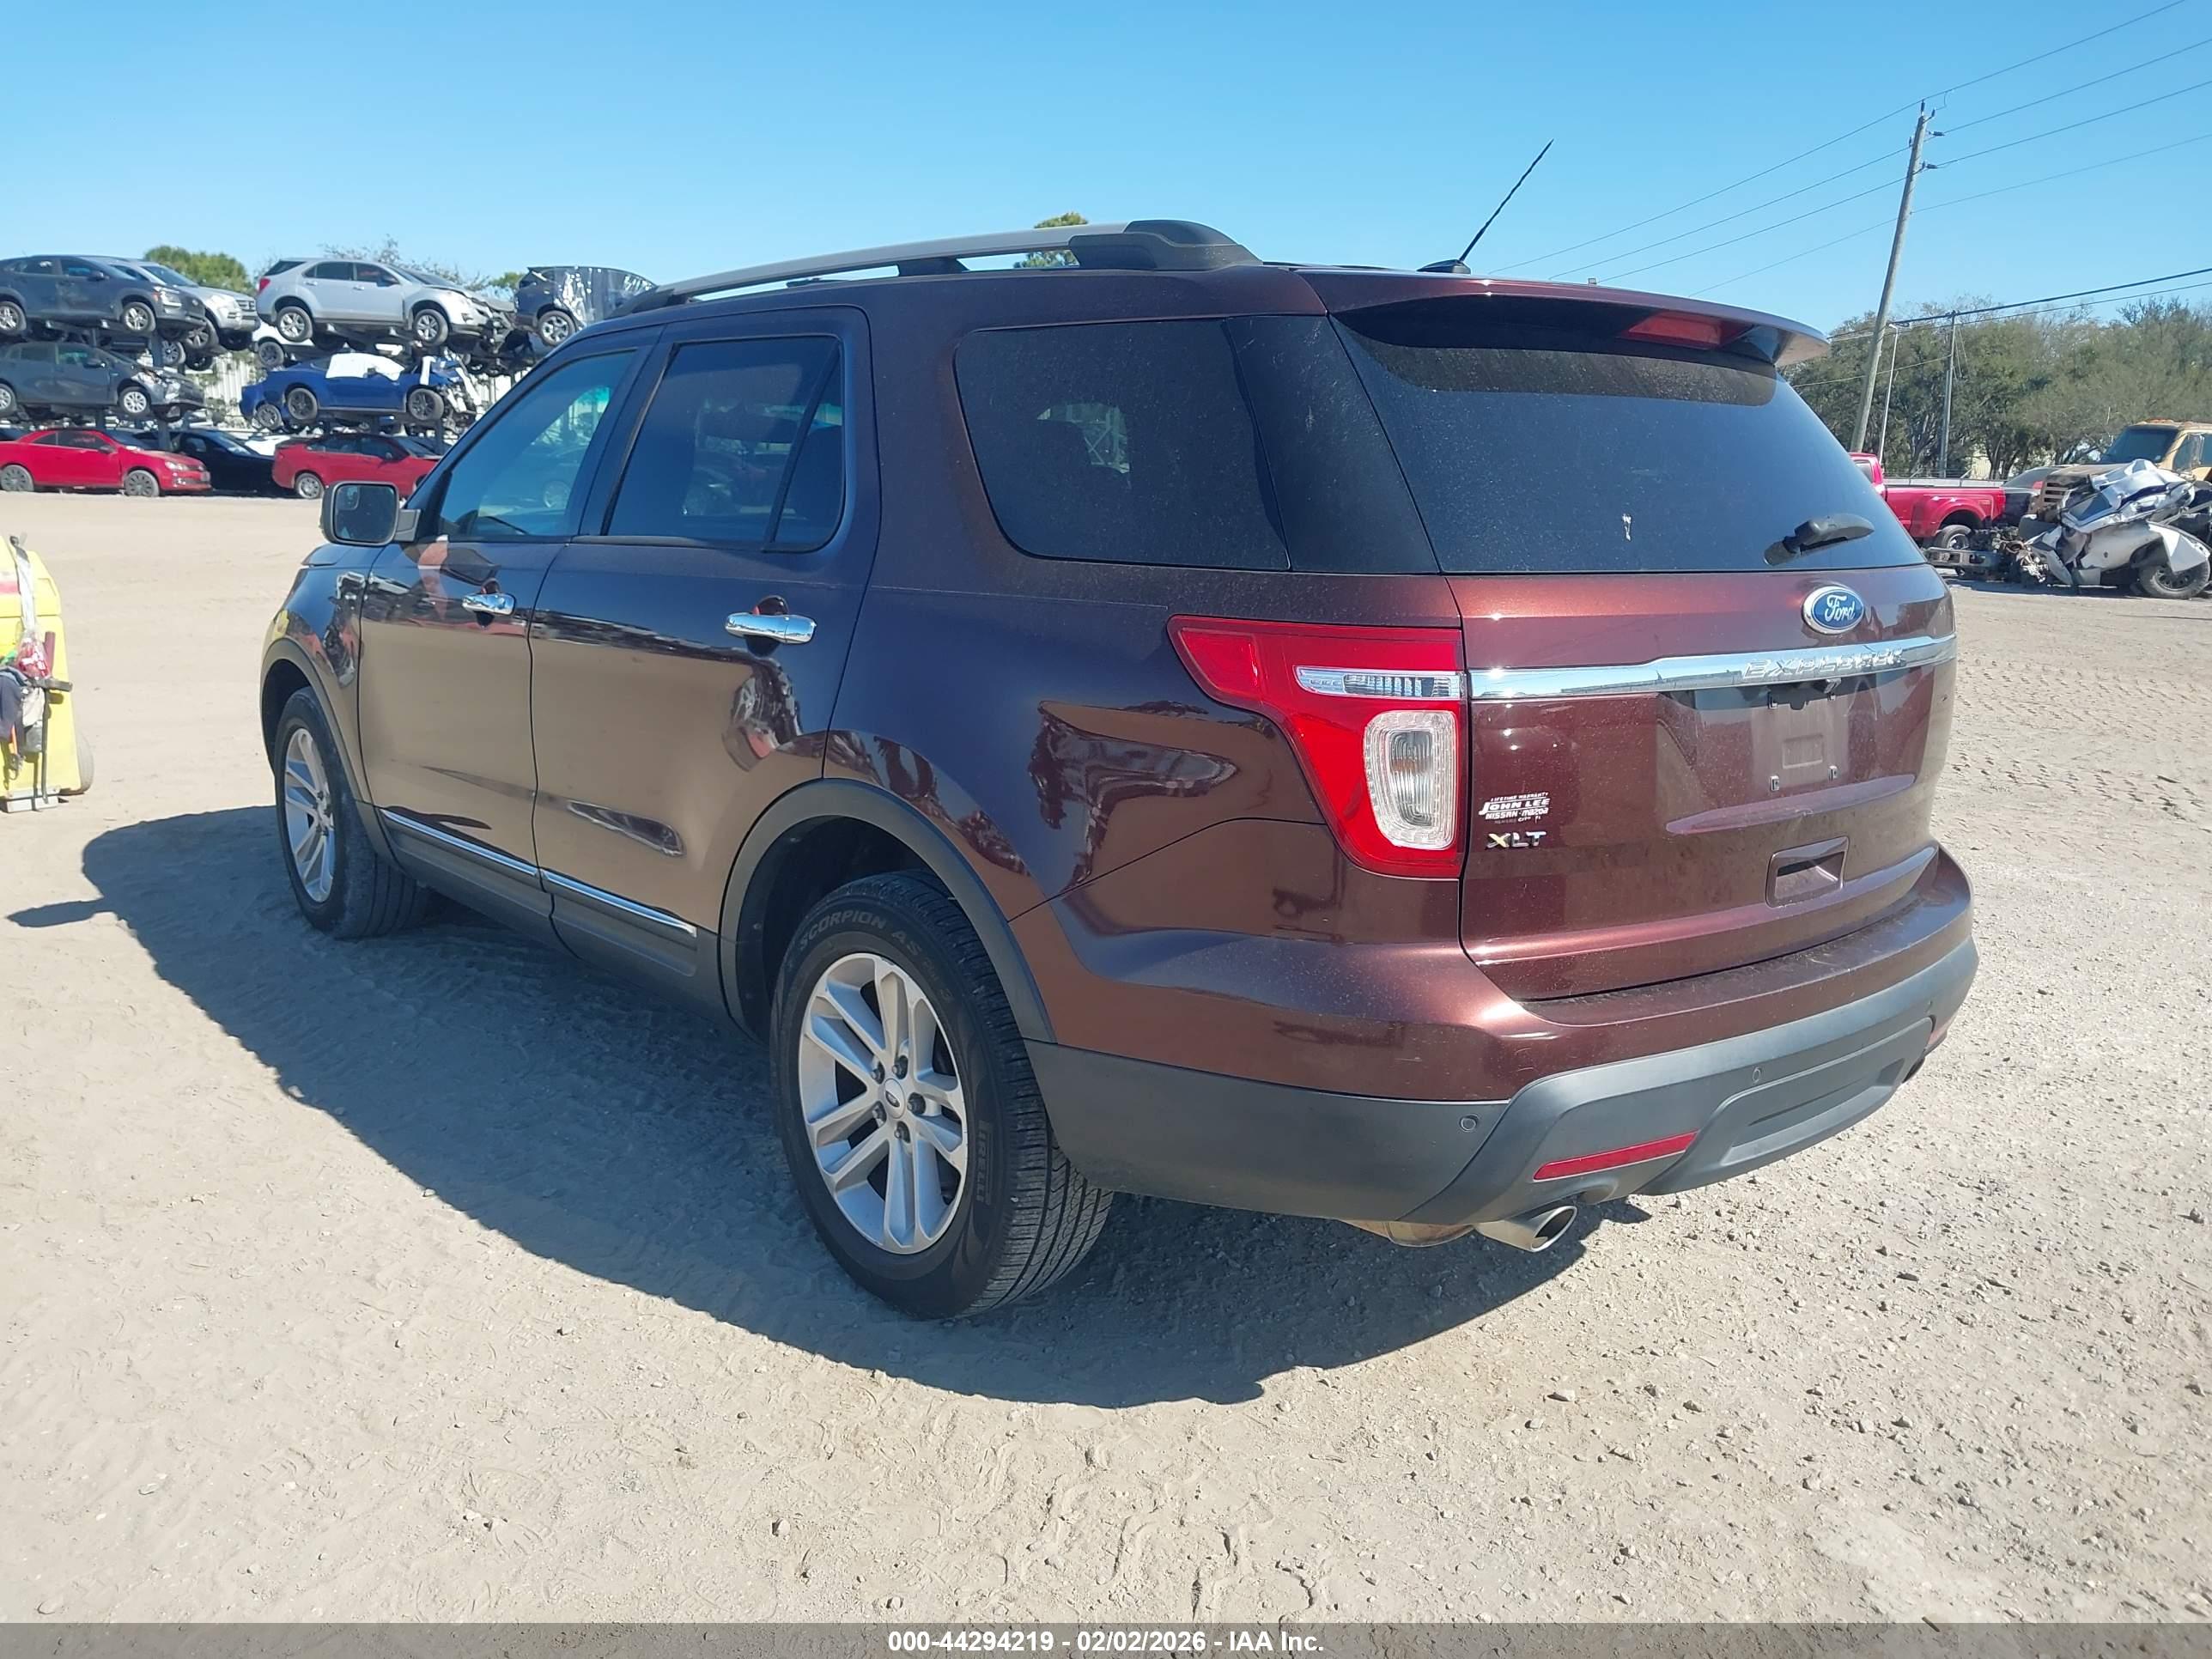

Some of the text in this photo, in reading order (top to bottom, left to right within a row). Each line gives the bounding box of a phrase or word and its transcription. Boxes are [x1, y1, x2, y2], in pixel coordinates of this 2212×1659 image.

[1824, 594, 1855, 623] Ford
[1742, 648, 1904, 679] EXPLORER
[1479, 798, 1551, 815] JOHN LEE
[1485, 811, 1518, 820] NISSAN
[1486, 831, 1547, 848] XLT
[799, 909, 887, 951] SCORPION
